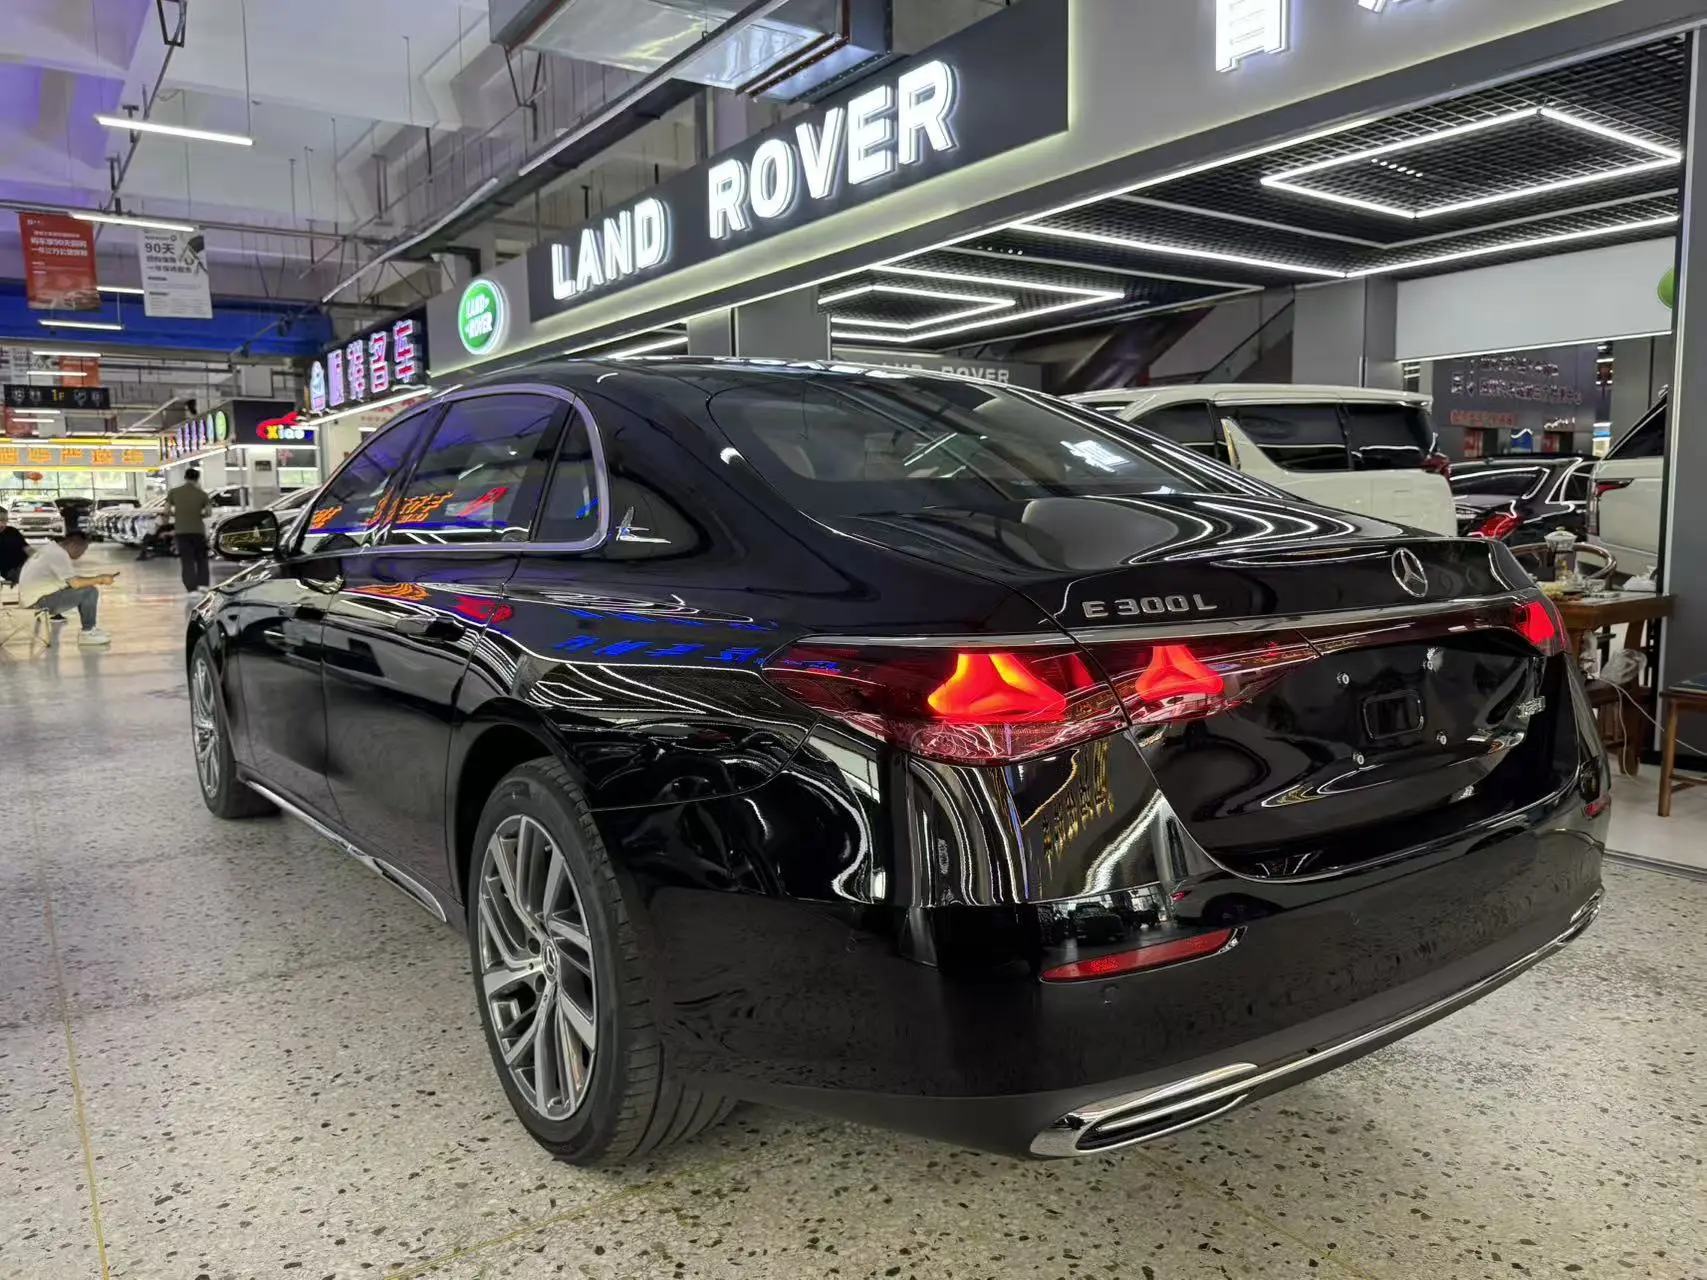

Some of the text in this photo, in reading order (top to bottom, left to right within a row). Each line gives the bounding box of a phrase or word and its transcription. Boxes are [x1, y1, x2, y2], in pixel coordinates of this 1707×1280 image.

[550, 58, 960, 300] LAND ROVER
[1081, 593, 1218, 618] E 300 L
